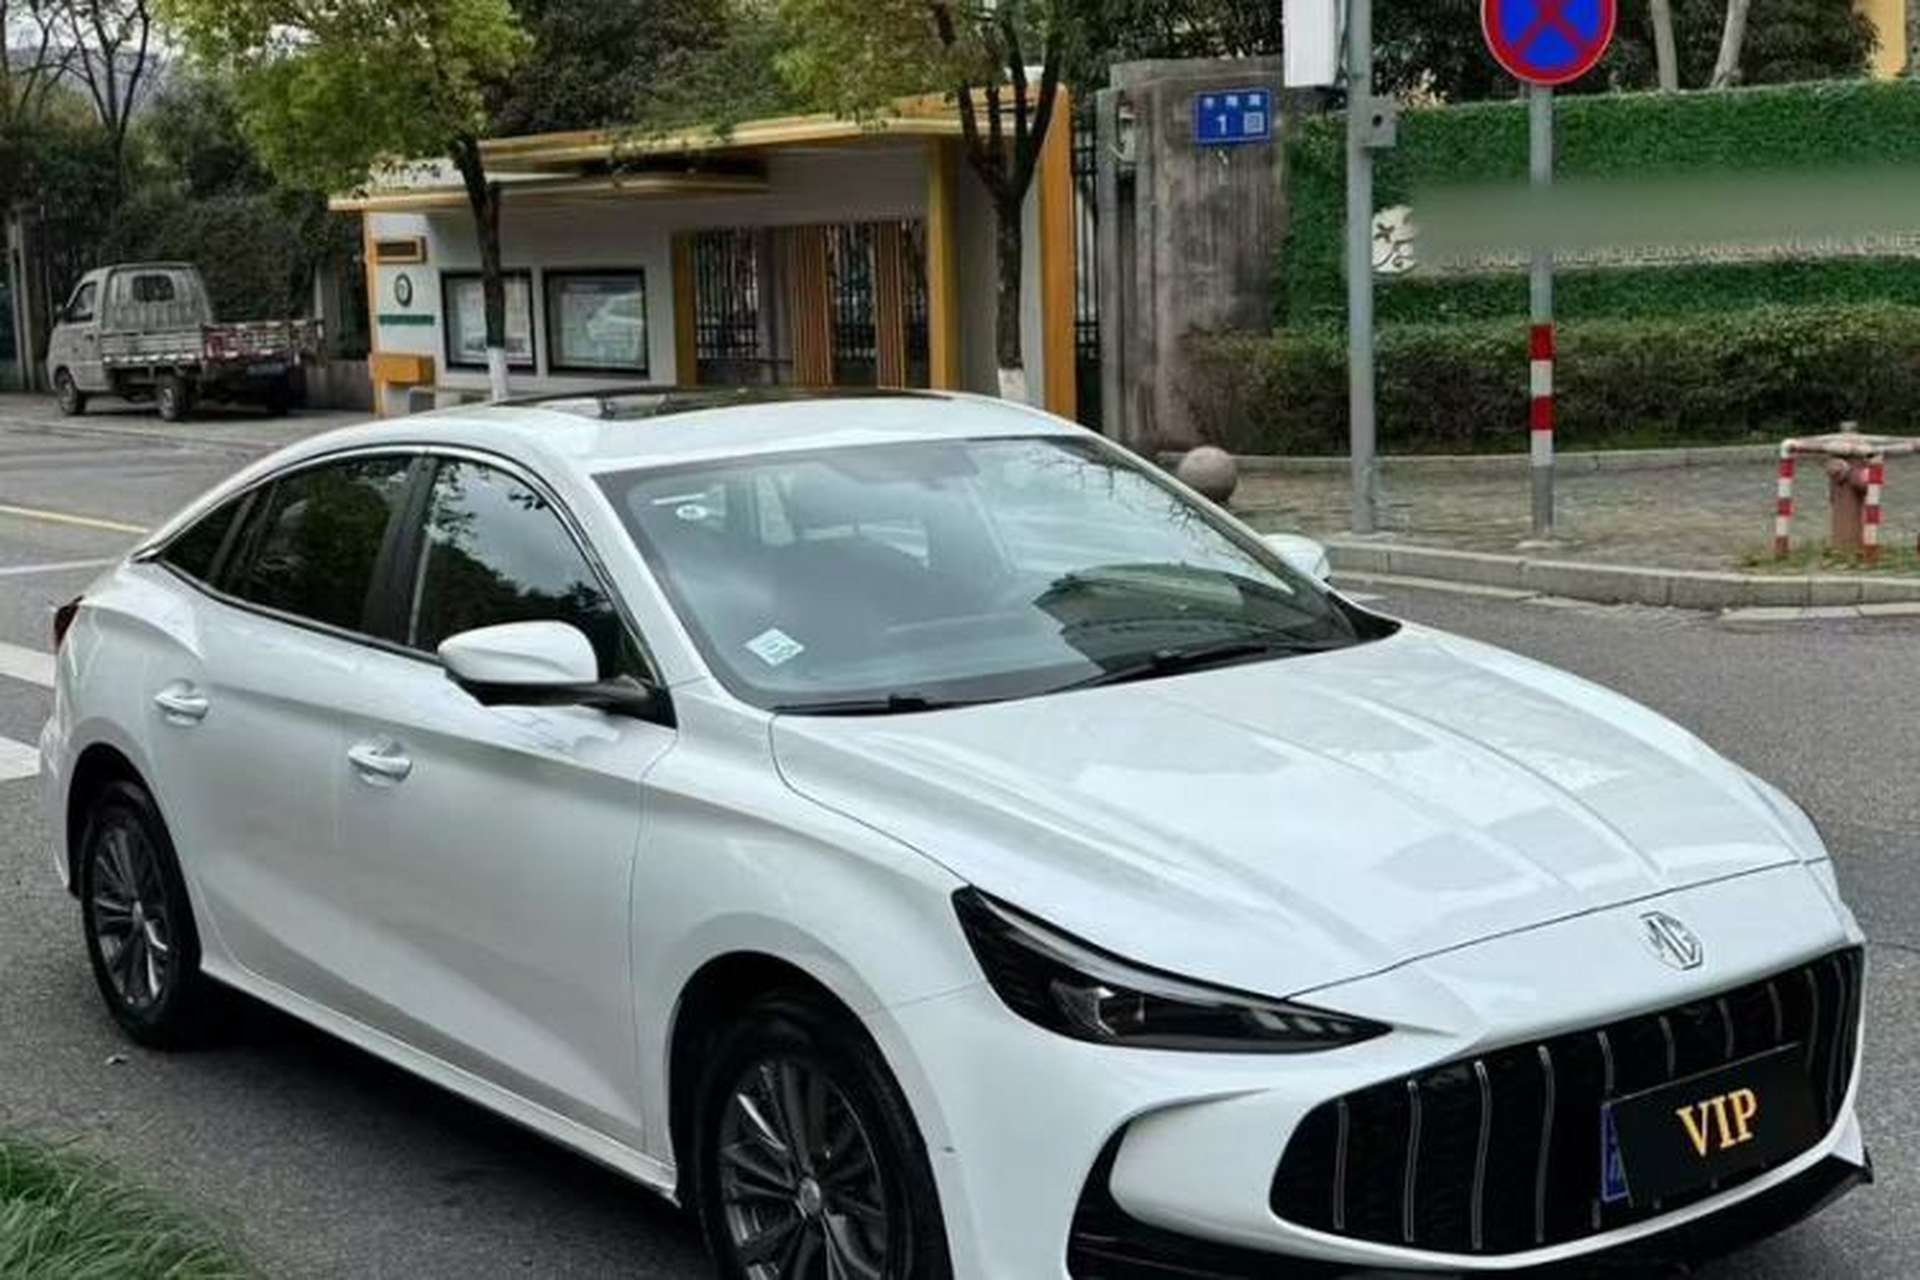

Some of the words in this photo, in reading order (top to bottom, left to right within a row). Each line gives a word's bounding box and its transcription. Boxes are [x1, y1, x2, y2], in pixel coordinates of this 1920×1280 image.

[1216, 114, 1228, 136] 1
[1642, 911, 1703, 970] MG
[1675, 1087, 1758, 1157] VIP
